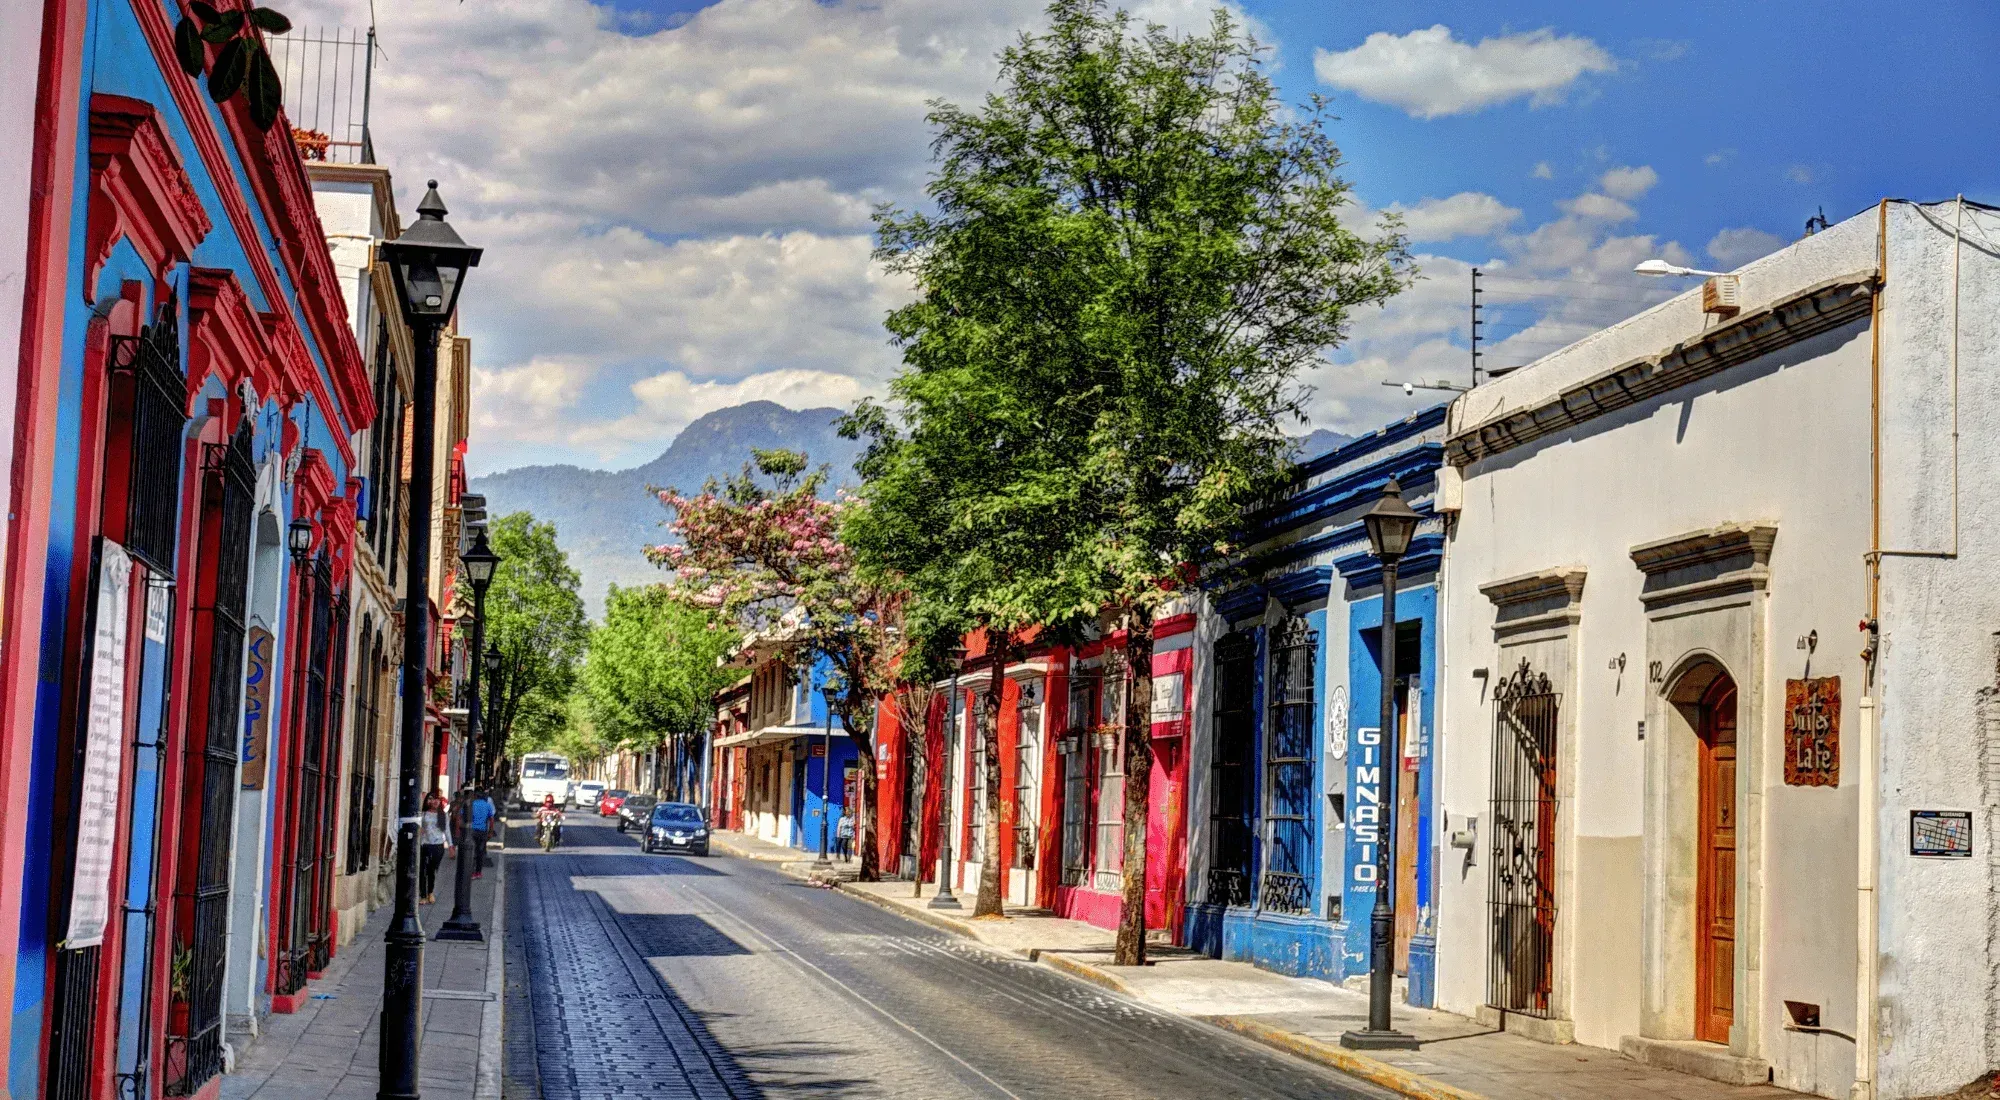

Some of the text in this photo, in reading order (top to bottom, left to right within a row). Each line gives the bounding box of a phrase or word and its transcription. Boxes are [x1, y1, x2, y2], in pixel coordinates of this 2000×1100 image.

[1649, 661, 1662, 684] 102
[1793, 692, 1830, 739] Suites
[1797, 737, 1831, 769] La Fe
[1354, 727, 1380, 882] GIMNASIO
